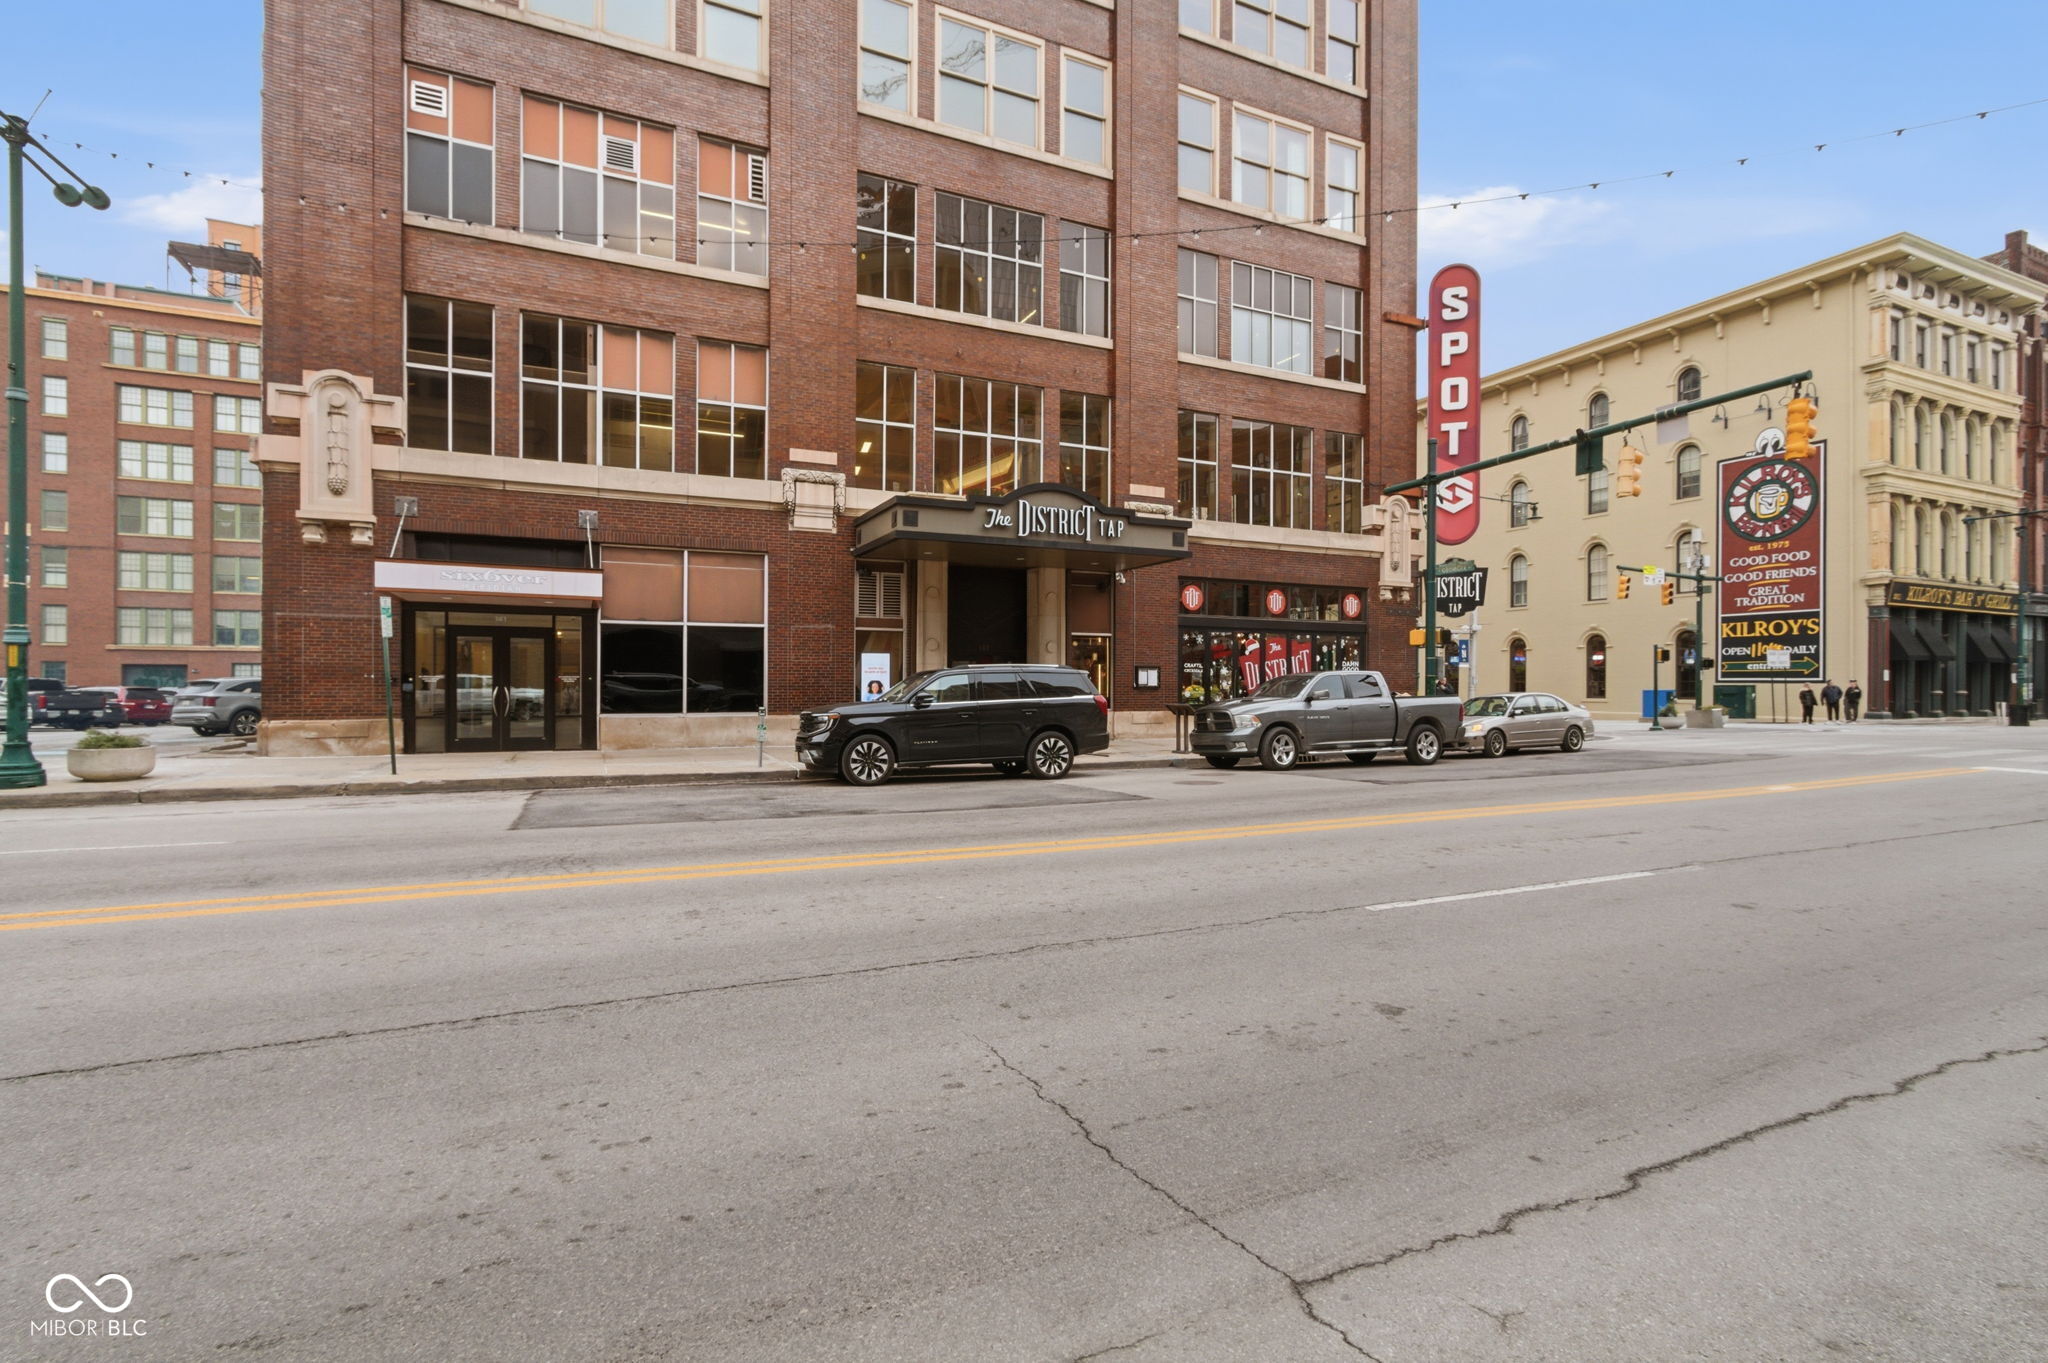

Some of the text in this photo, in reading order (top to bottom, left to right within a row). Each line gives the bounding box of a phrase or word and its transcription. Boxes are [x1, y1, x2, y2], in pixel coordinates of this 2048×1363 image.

[1440, 286, 1469, 456] SPOT
[1729, 465, 1812, 507] KILROY'S
[984, 499, 1125, 542] The DISTRICT TAP
[1729, 550, 1811, 567] GOOD FOOD
[1724, 566, 1817, 583] GOOD FRIENDS
[1437, 572, 1483, 601] ISTRICT
[1748, 585, 1789, 597] GREAT
[1448, 603, 1462, 613] TAP
[1734, 593, 1805, 607] TRADITION
[1721, 618, 1820, 638] KILROY'S
[1269, 642, 1282, 653] The
[1722, 647, 1752, 656] OPEN
[1784, 645, 1818, 655] DAILY
